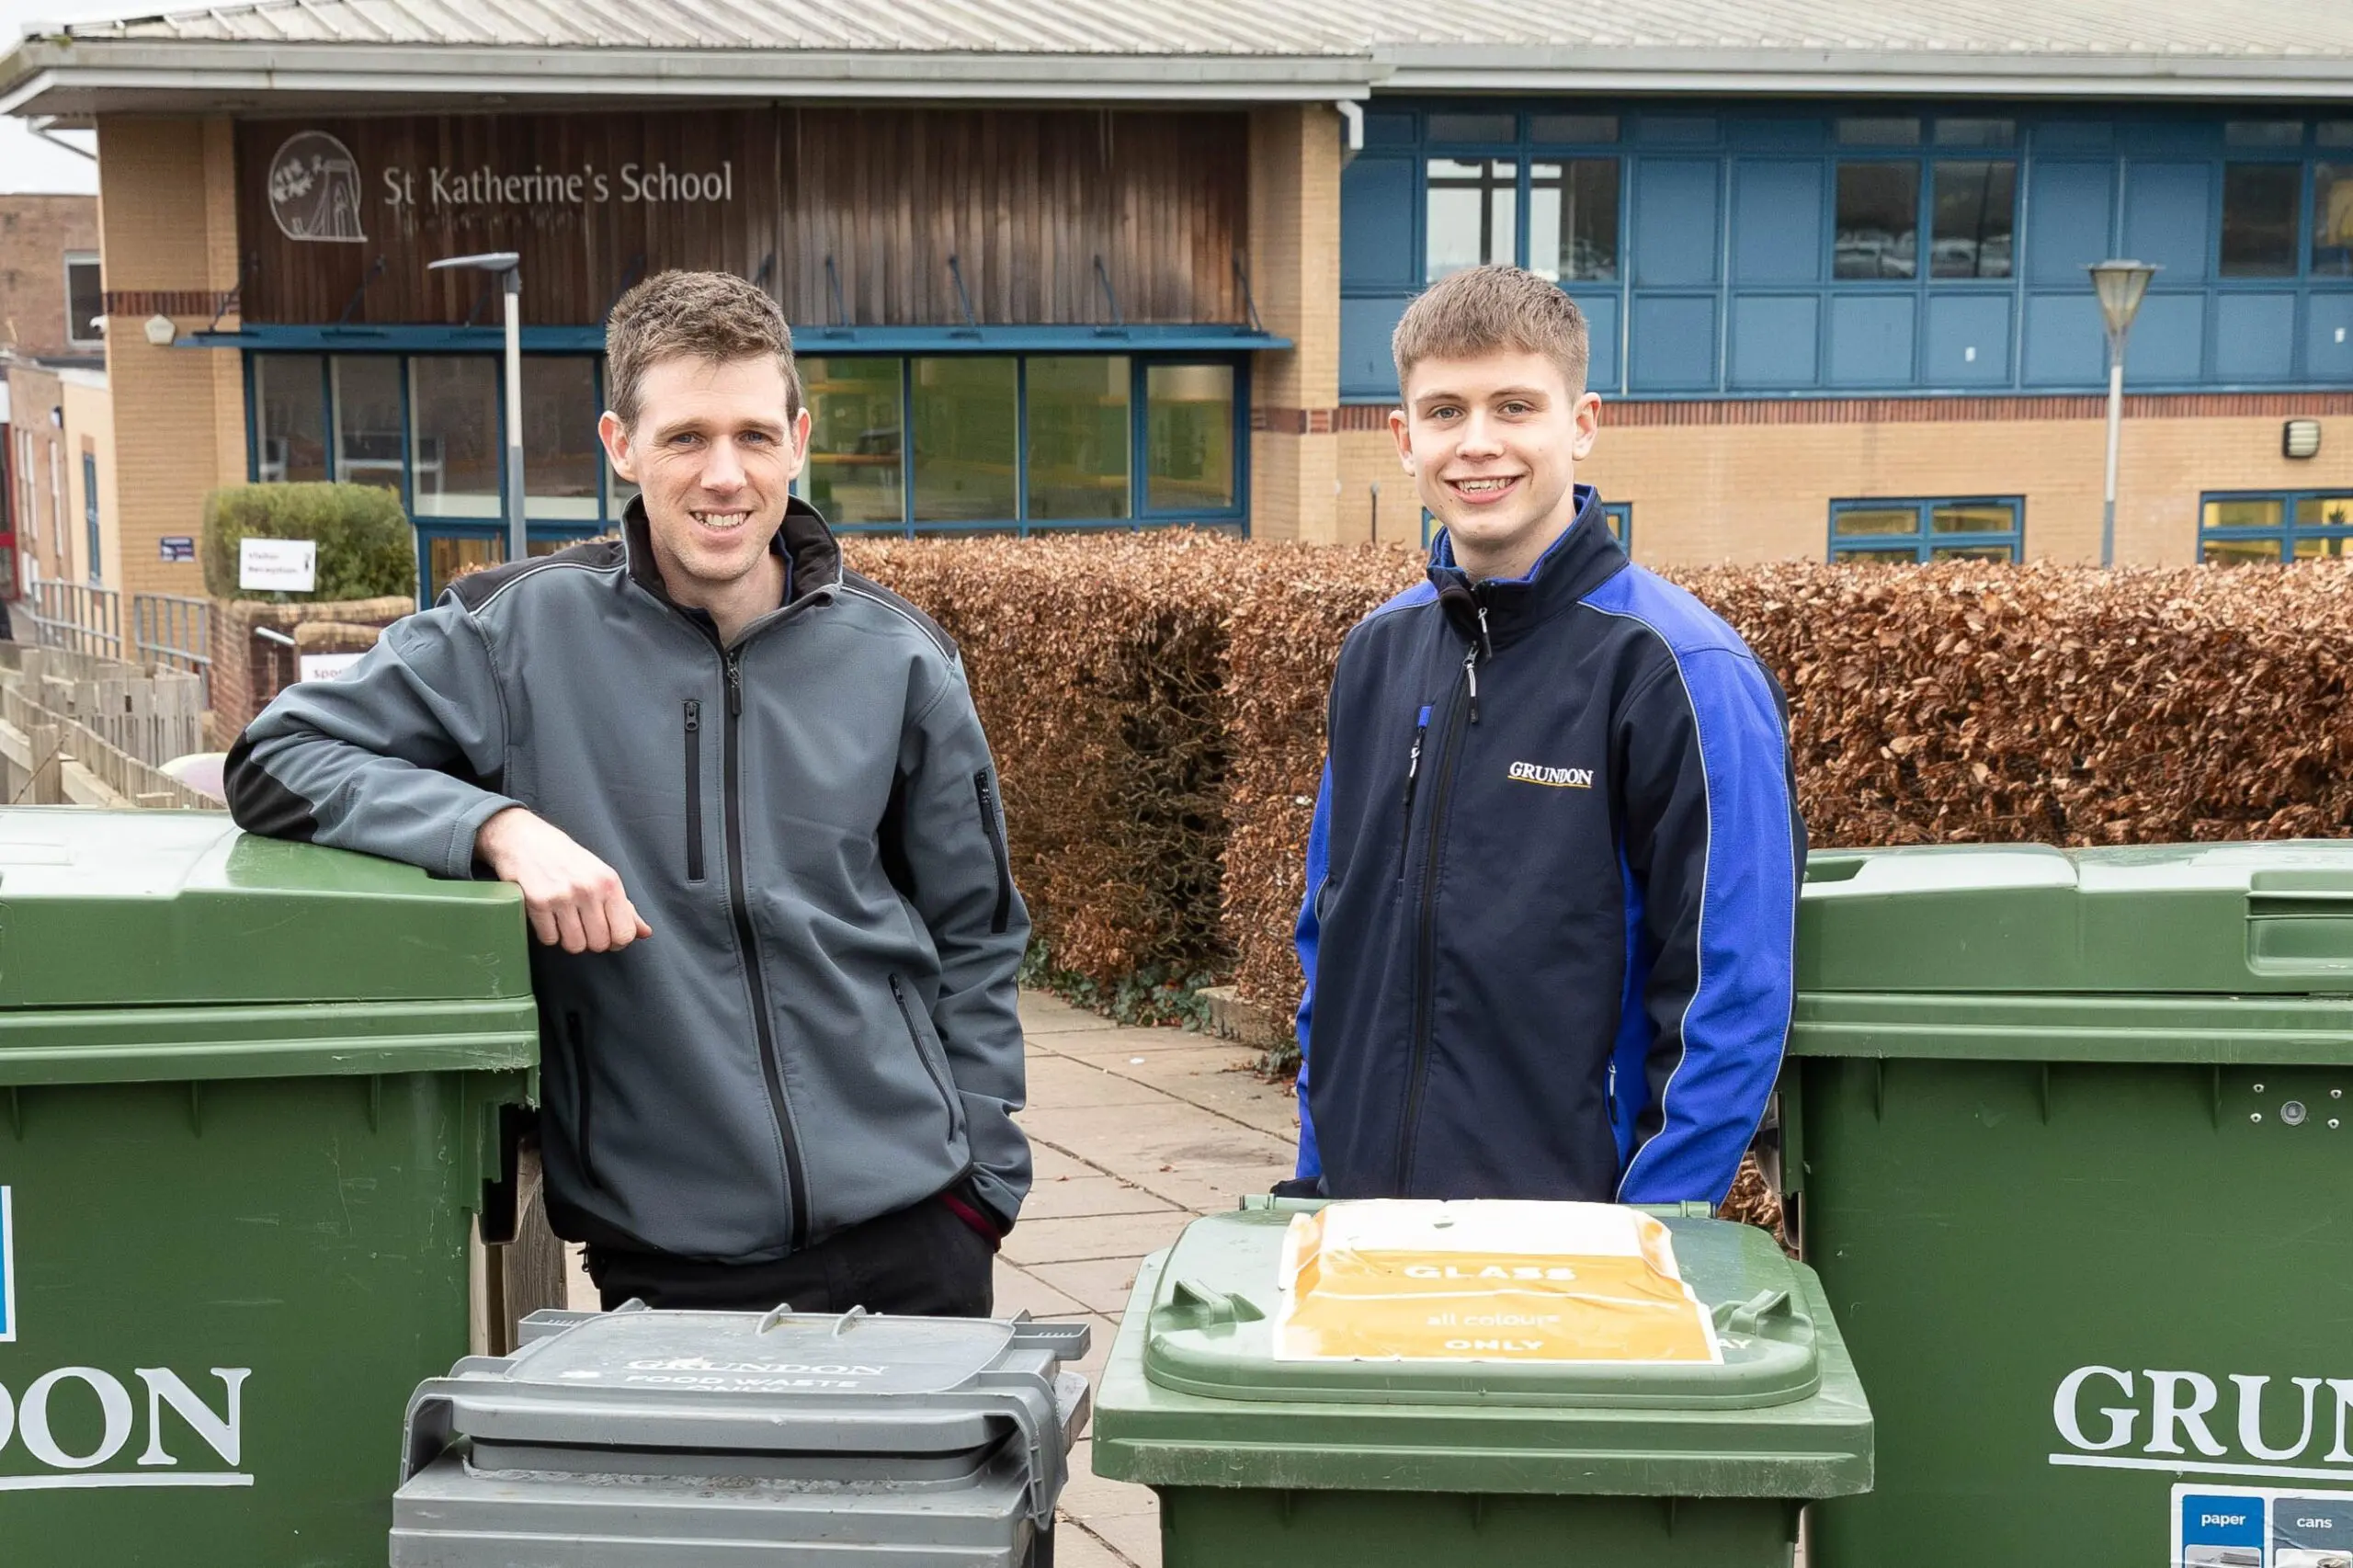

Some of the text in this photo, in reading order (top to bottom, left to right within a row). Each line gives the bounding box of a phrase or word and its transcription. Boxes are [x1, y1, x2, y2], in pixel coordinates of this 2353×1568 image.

[382, 160, 733, 206] St Katherine's School
[1509, 761, 1594, 785] GRUNDON
[1404, 1266, 1577, 1280] GLASS
[1427, 1313, 1457, 1325] all
[1445, 1339, 1544, 1350] ONLY
[625, 1375, 861, 1388] FOOD WASTE
[2200, 1514, 2246, 1528] paper
[2297, 1517, 2333, 1528] cans
